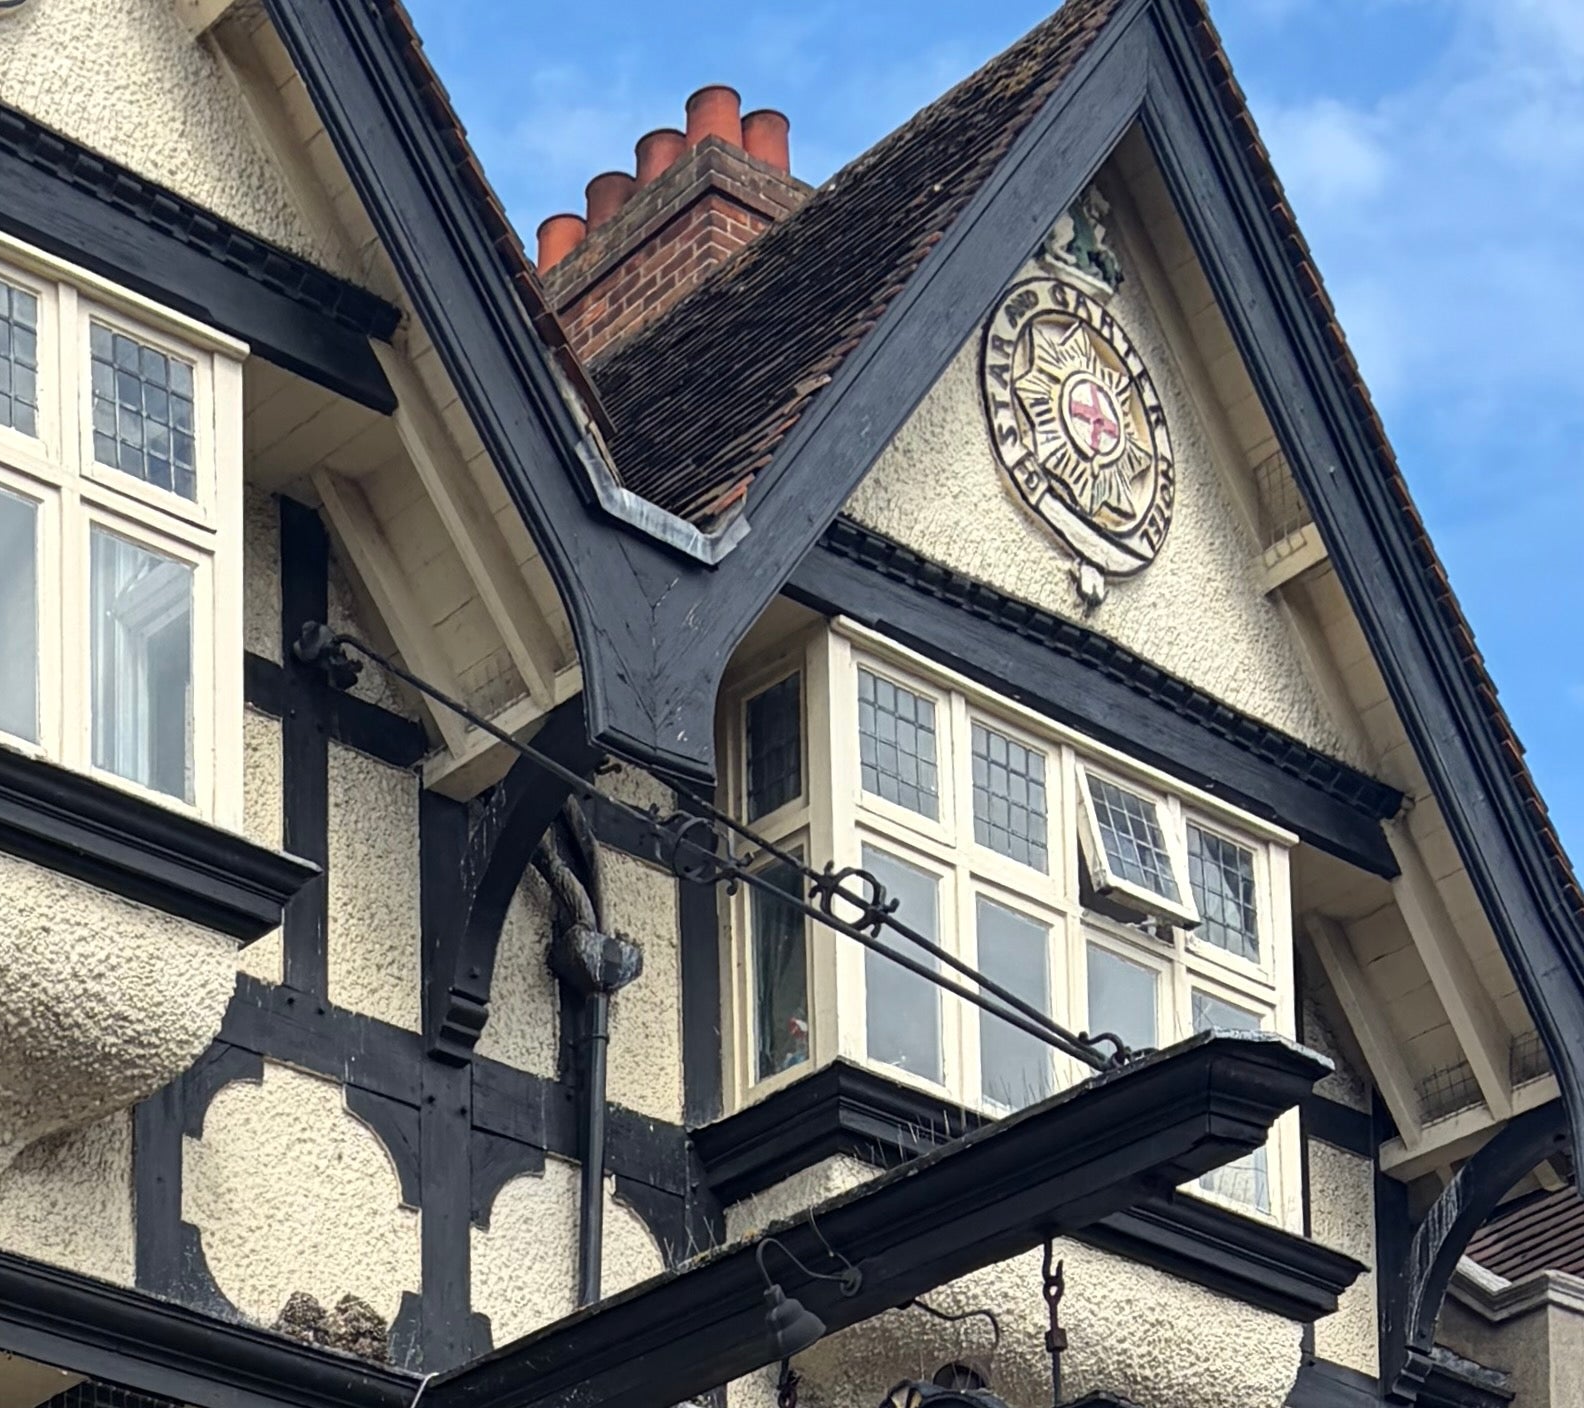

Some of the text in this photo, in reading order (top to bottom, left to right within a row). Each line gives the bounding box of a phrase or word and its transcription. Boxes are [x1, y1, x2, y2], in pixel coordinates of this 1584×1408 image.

[989, 283, 1174, 552] STAR AND GARTER HOTEL
